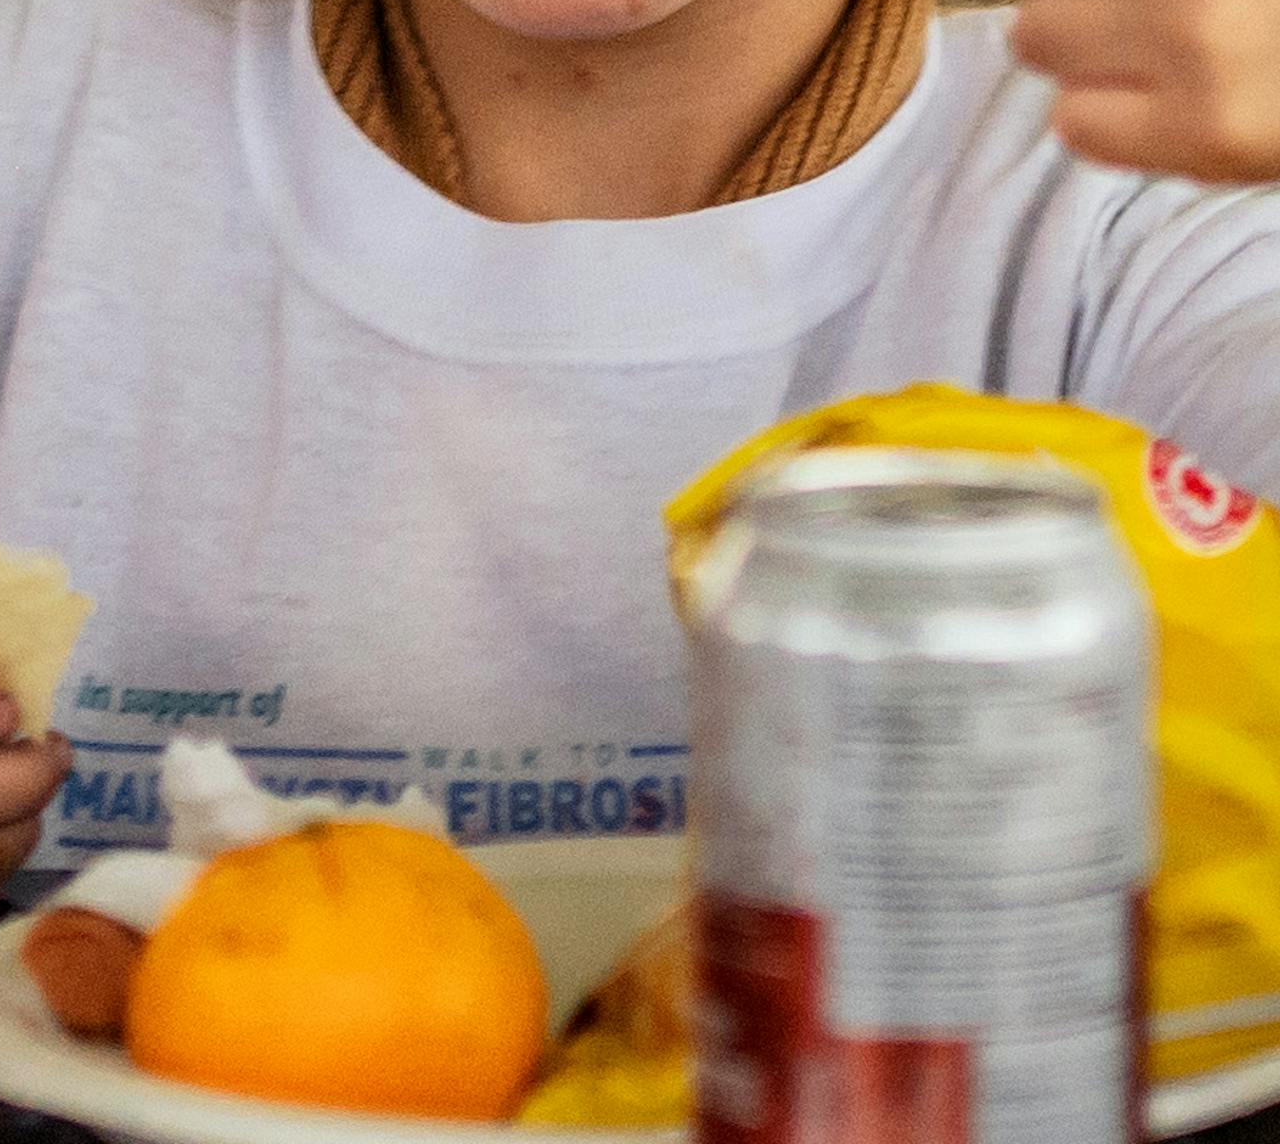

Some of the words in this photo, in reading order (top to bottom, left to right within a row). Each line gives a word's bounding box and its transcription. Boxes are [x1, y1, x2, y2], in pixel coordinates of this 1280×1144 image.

[120, 686, 242, 727] support
[250, 682, 288, 727] of
[447, 775, 687, 834] FIBROSI
